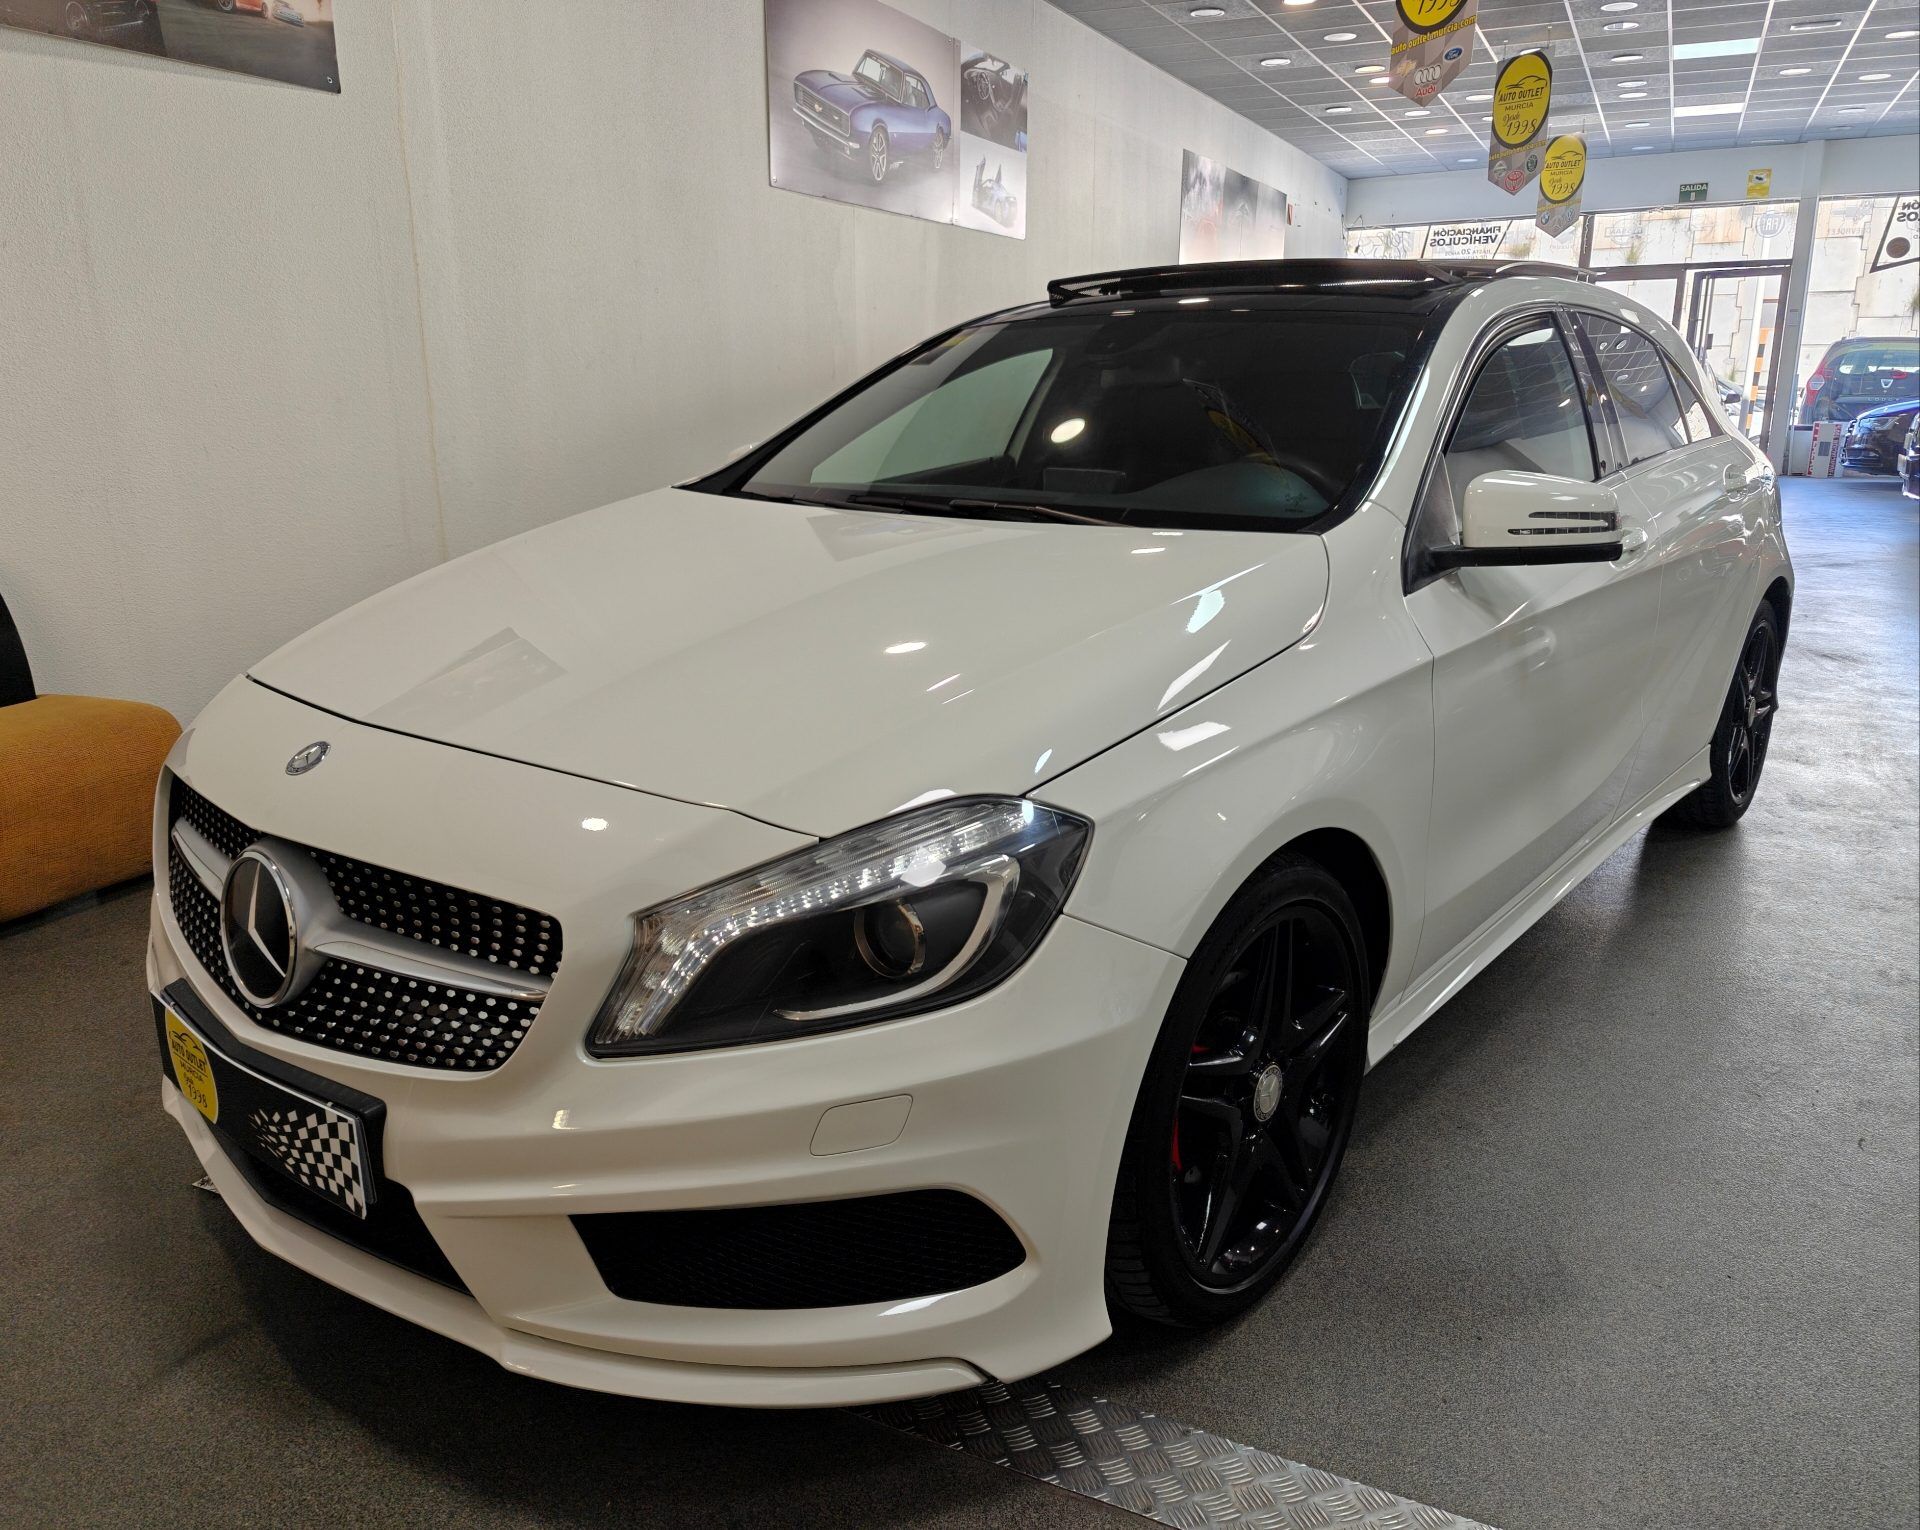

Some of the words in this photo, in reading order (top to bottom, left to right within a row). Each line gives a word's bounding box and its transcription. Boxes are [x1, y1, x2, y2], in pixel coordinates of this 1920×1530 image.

[1415, 85, 1436, 97] Audi
[1498, 91, 1516, 102] AUTO
[1518, 87, 1544, 99] OUTLET
[1504, 102, 1534, 111] MURCIA
[1506, 118, 1537, 136] 1998
[1560, 160, 1580, 168] OUTLET
[1551, 182, 1575, 195] 1998
[1680, 184, 1707, 192] SALIDA
